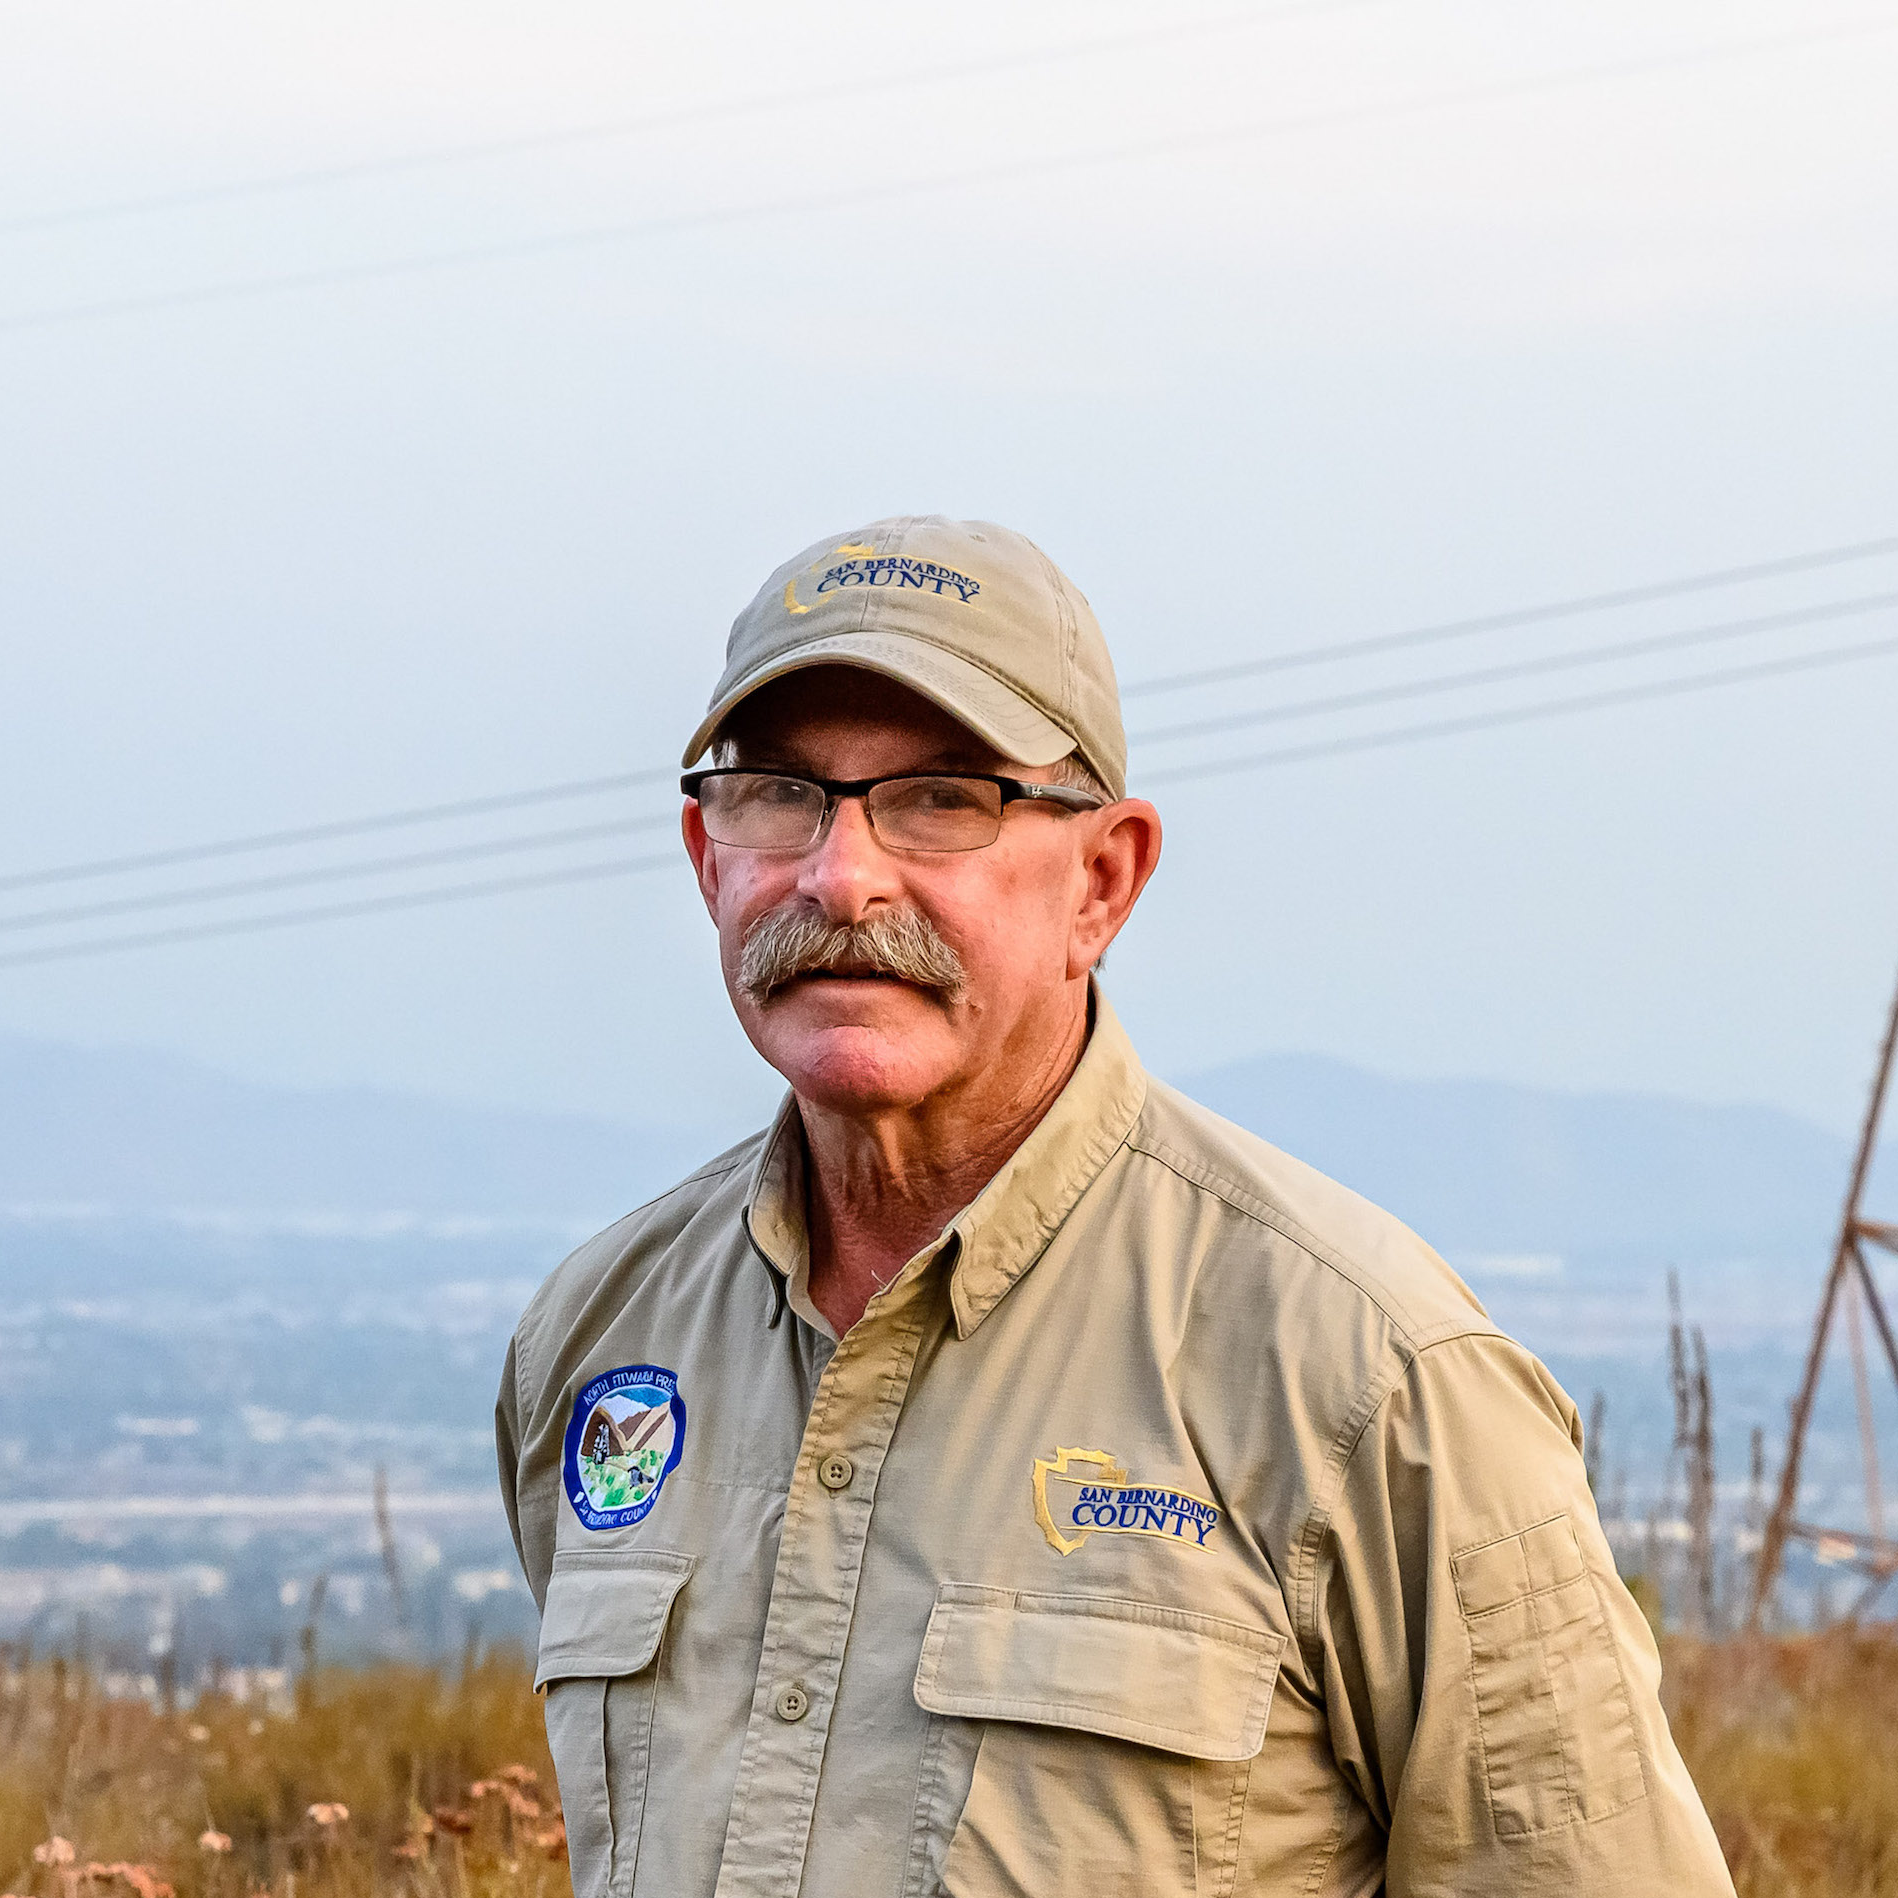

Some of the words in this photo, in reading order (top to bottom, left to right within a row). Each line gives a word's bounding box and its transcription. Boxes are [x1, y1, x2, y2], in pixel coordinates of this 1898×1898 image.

[817, 569, 981, 604] COUNTY
[825, 561, 858, 579] SAN
[865, 557, 981, 591] BERNARDINO
[583, 1379, 611, 1406] NORTH
[1079, 1487, 1113, 1503] SAN
[1117, 1489, 1218, 1524] BERNARDINO
[1072, 1502, 1216, 1546] COUNTY
